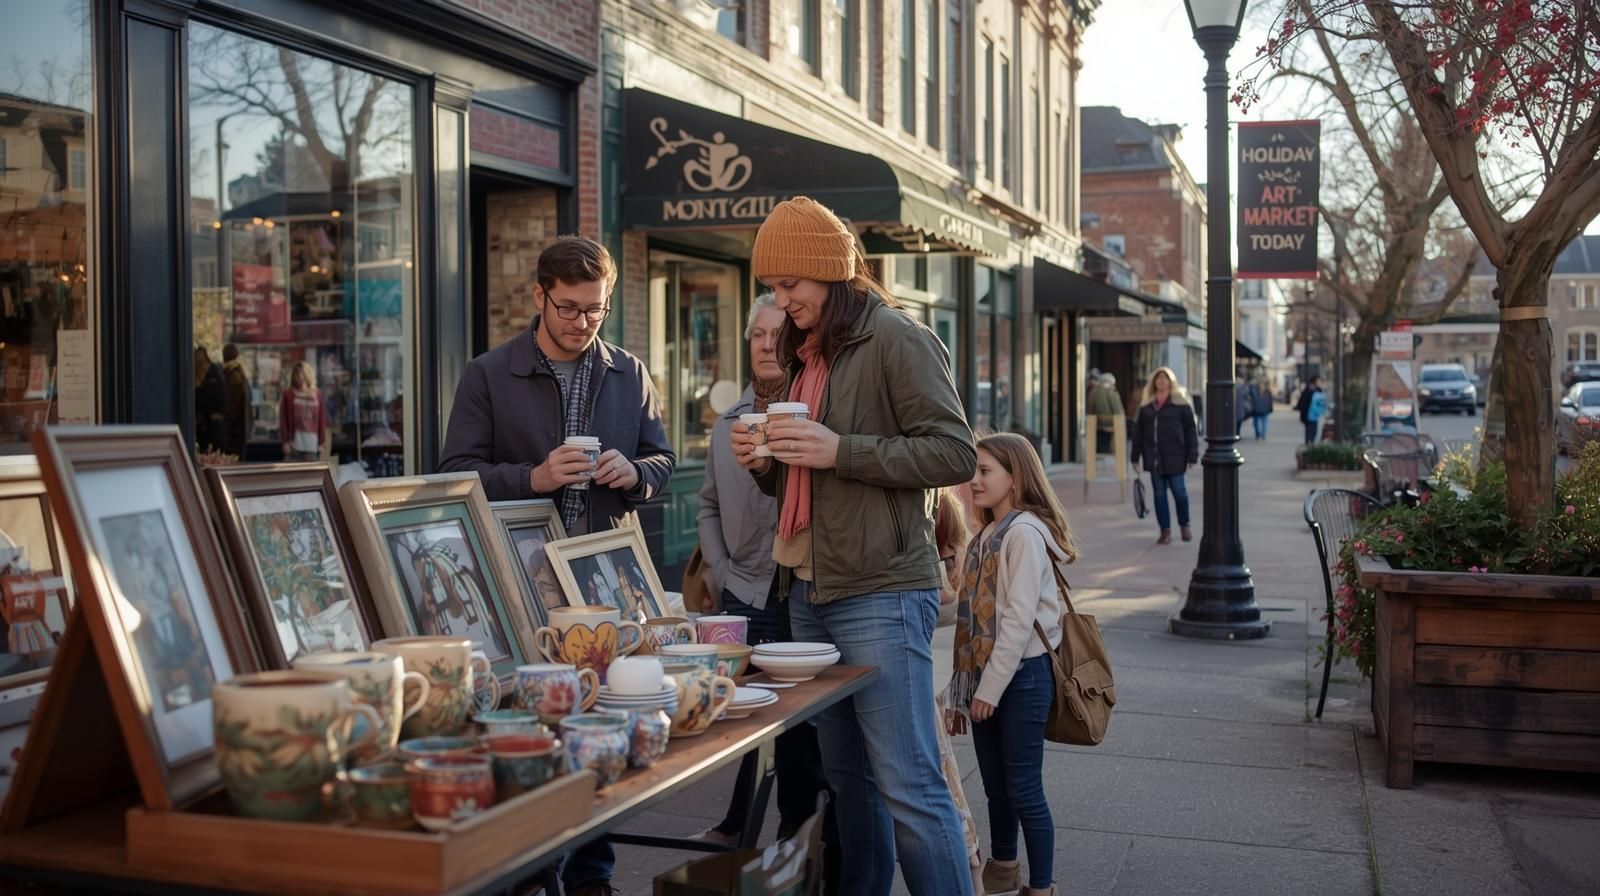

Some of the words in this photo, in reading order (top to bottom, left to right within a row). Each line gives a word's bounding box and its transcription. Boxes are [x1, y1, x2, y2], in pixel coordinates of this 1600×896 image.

[1241, 147, 1316, 163] HOLIDAY
[1261, 185, 1297, 204] ART
[1244, 204, 1318, 226] MARKET
[1249, 234, 1306, 250] TODAY
